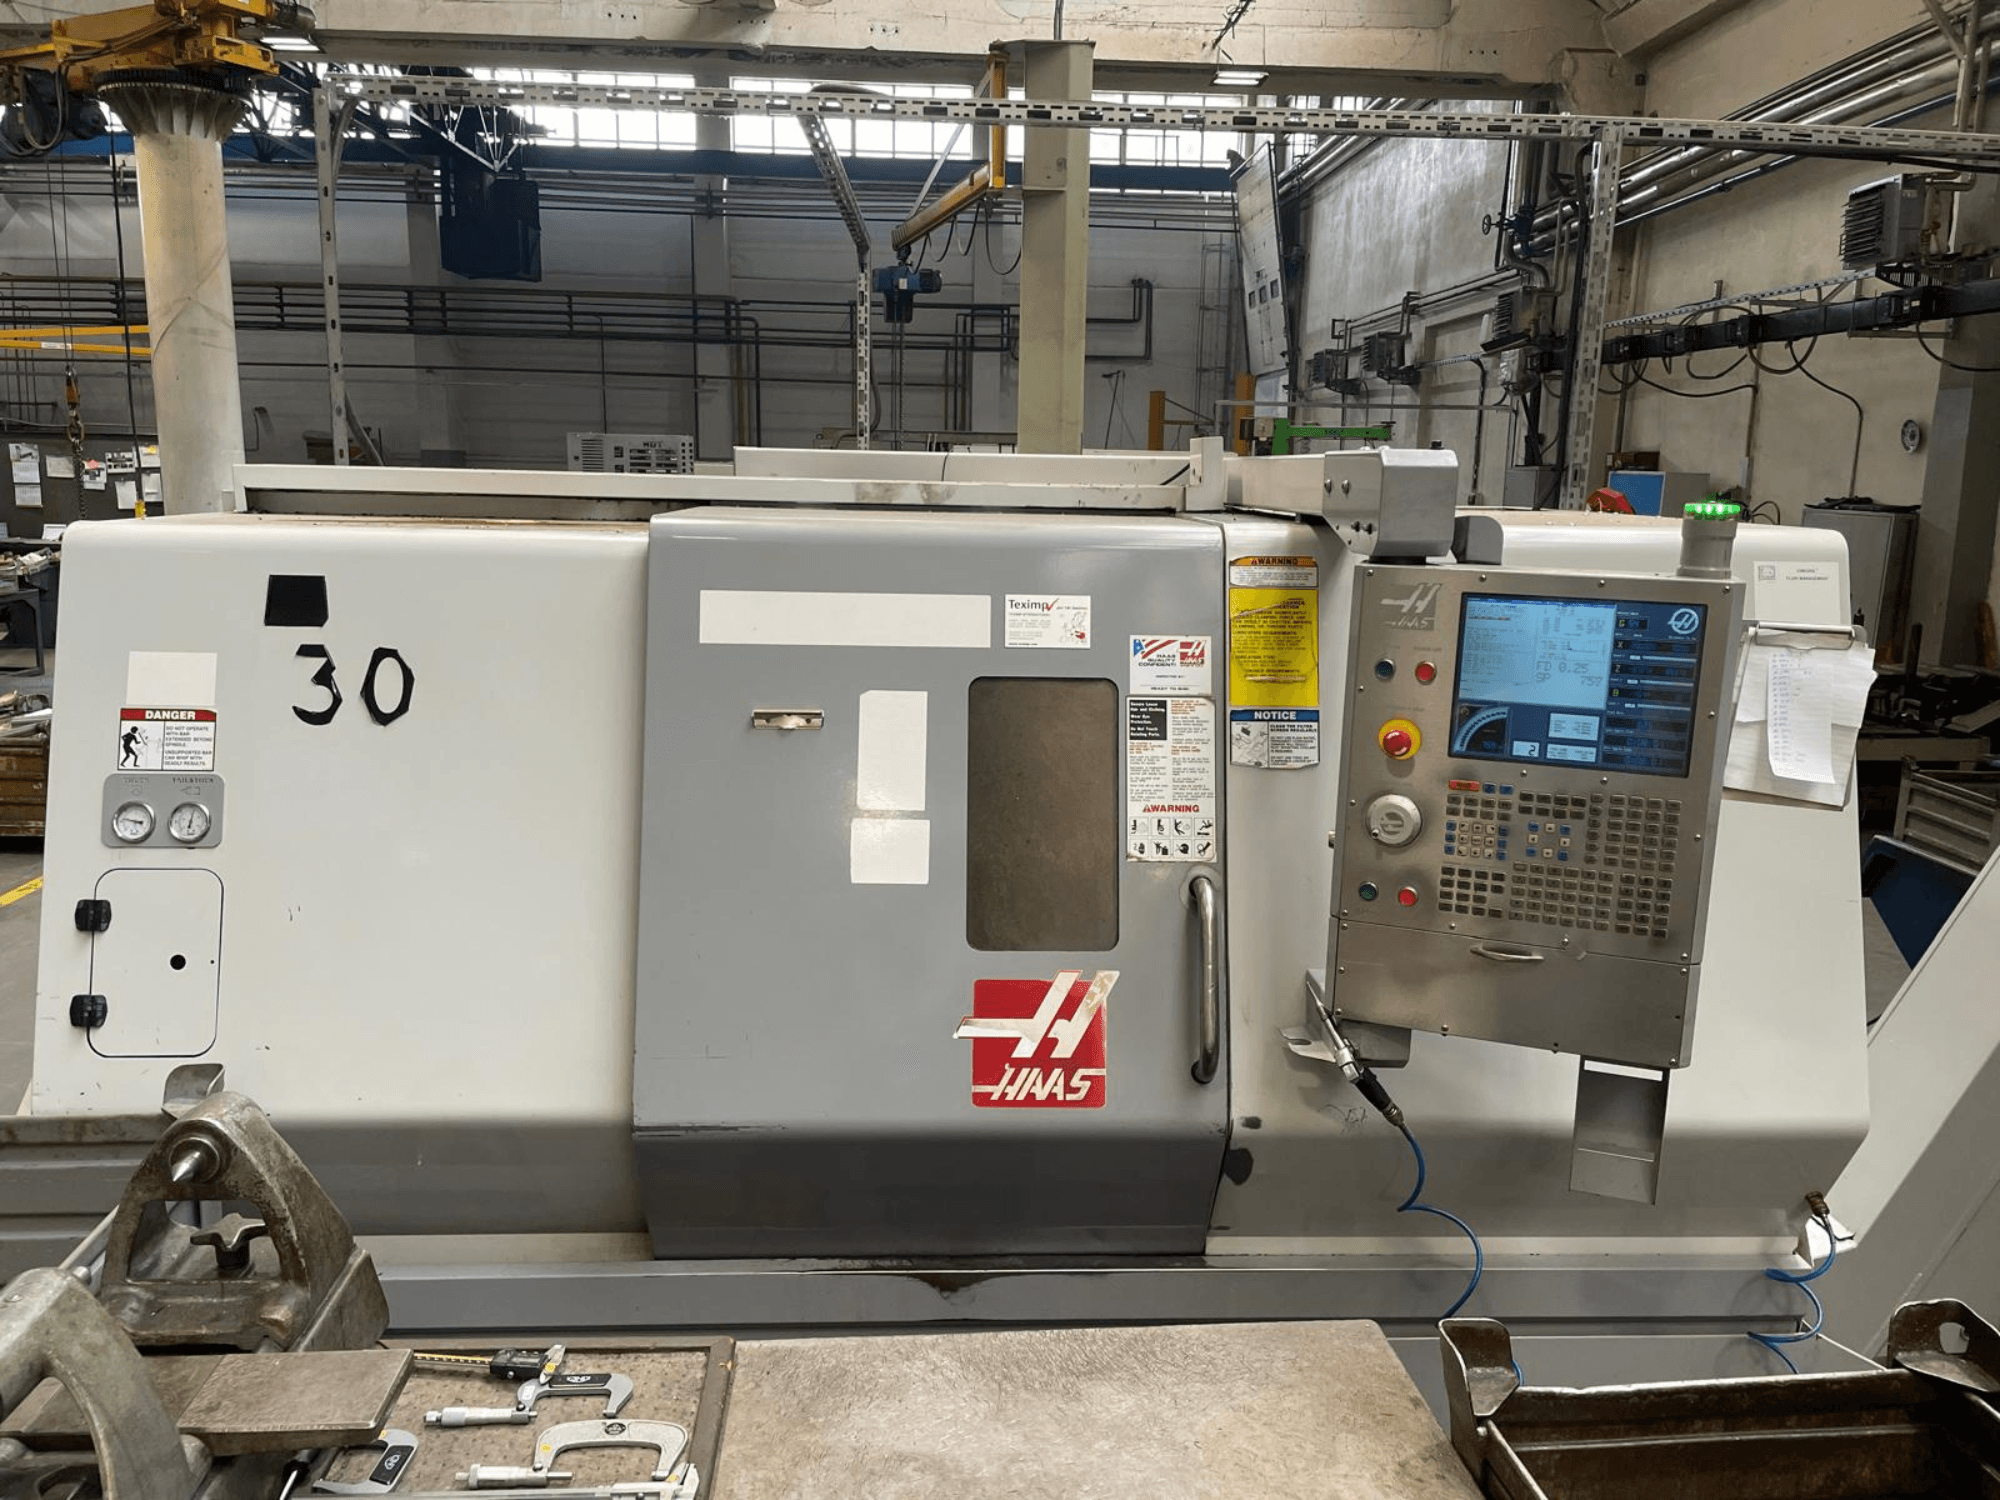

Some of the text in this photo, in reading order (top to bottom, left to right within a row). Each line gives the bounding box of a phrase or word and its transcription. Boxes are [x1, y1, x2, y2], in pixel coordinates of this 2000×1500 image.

[1258, 556, 1299, 565] WARNING
[1008, 599, 1050, 612] Teximp
[292, 644, 415, 726] 30
[144, 710, 196, 720] DANGER
[1254, 711, 1297, 720] NOTICE
[1528, 744, 1536, 756] 2
[1150, 804, 1200, 813] WARNING
[973, 1068, 1106, 1101] HAAS
